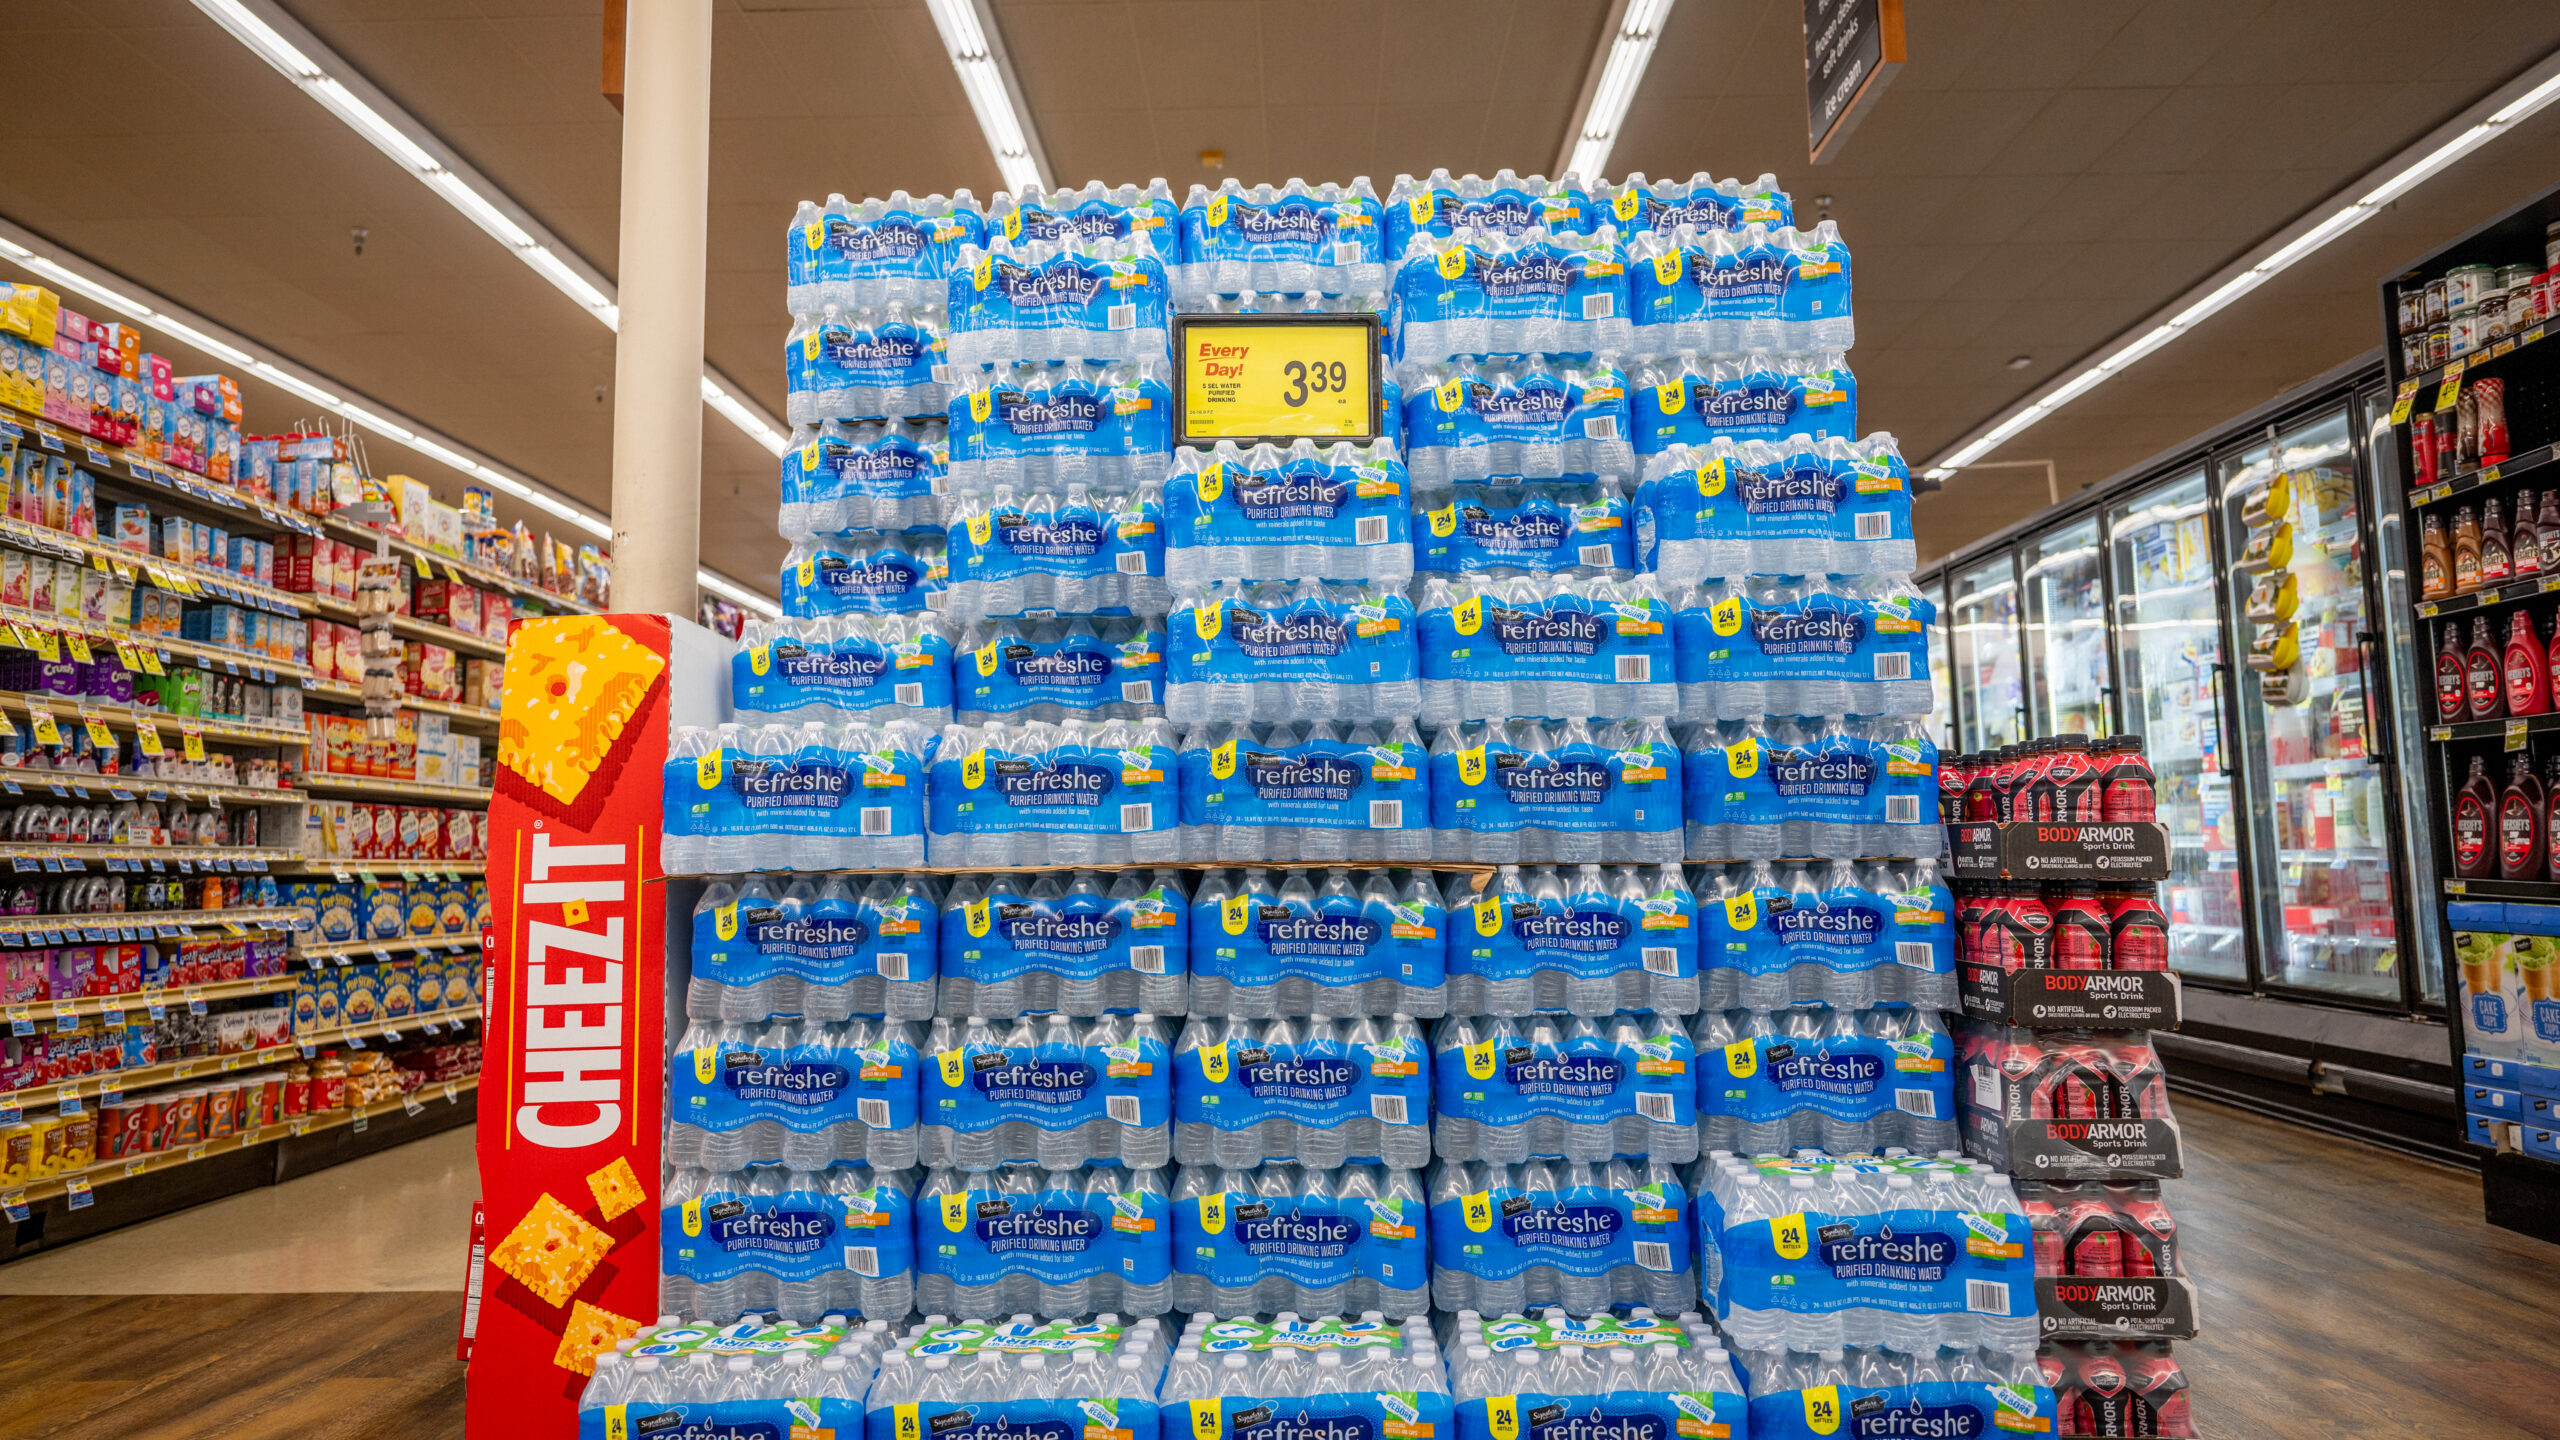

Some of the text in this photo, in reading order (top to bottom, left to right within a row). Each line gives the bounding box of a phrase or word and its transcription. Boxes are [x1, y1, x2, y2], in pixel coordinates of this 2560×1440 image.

[1825, 59, 1862, 120] ice cream
[1244, 209, 1320, 232] refreshe
[1451, 202, 1526, 227] refreshe
[1654, 200, 1728, 224] refreshe
[841, 227, 917, 249] refreshe
[1010, 264, 1092, 294] refreshe
[1483, 260, 1567, 284] refreshe
[1701, 260, 1782, 284] refreshe
[836, 341, 913, 358] refreshe
[1199, 344, 1249, 360] Every
[1205, 363, 1244, 378] Day!
[1011, 399, 1095, 422] refreshe
[1481, 389, 1564, 411] refreshe
[1704, 389, 1787, 413] refreshe
[837, 451, 914, 469] refreshe
[1204, 475, 1217, 488] 24
[1746, 473, 1835, 499] refreshe
[1244, 481, 1336, 504] refreshe
[1247, 506, 1333, 519] PURIFIED DRINKING WATER
[1011, 521, 1097, 542] refreshe
[1475, 518, 1559, 537] refreshe
[831, 568, 907, 586] refreshe
[1242, 618, 1337, 642] refreshe
[1503, 615, 1596, 639] refreshe
[1760, 615, 1853, 638] refreshe
[44, 663, 74, 676] Crush
[788, 654, 876, 674] refreshe
[1016, 654, 1102, 672] refreshe
[111, 670, 132, 682] Crush
[183, 682, 200, 694] Crush
[968, 764, 978, 775] 24
[1257, 760, 1350, 786] refreshe
[1466, 760, 1479, 771] 24
[1776, 756, 1866, 782] refreshe
[744, 765, 841, 792] refreshe
[1007, 765, 1101, 791] refreshe
[1508, 764, 1602, 789] refreshe
[1010, 793, 1098, 806] PURIFIED DRINKING WATER
[1960, 827, 1991, 842] BODYARMOR
[2038, 826, 2135, 842] BODYARMOR
[2083, 842, 2110, 851] Sports
[1011, 915, 1108, 939] refreshe
[1524, 914, 1619, 937] refreshe
[1778, 907, 1873, 931] refreshe
[759, 921, 856, 943] refreshe
[1269, 918, 1368, 942] refreshe
[1015, 940, 1107, 952] PURIFIED DRINKING WATER
[1968, 968, 1998, 984] BODYARMOR
[2045, 976, 2144, 992] BODYARMOR
[16, 984, 36, 1002] Kool-Aid
[2090, 992, 2144, 1000] Sports Drink
[2480, 1000, 2498, 1016] CAKE
[1474, 1054, 1489, 1066] 24
[1517, 1057, 1613, 1081] refreshe
[1778, 1054, 1874, 1079] refreshe
[14, 1070, 34, 1088] Kool-Aid
[737, 1067, 836, 1089] refreshe
[986, 1065, 1083, 1088] refreshe
[1250, 1060, 1348, 1085] refreshe
[1782, 1080, 1873, 1094] PURIFIED DRINKING WATER
[2046, 1124, 2146, 1140] BODYARMOR
[2092, 1140, 2120, 1148] Sports
[1208, 1206, 1219, 1218] 24
[1514, 1209, 1610, 1233] refreshe
[723, 1213, 821, 1237] refreshe
[989, 1211, 1088, 1236] refreshe
[1247, 1215, 1348, 1241] refreshe
[1969, 1219, 2002, 1242] REBORN
[1782, 1229, 1799, 1243] 24
[1250, 1243, 1343, 1257] PURIFIED DRINKING WATER
[1832, 1234, 1943, 1262] refreshe
[1837, 1263, 1942, 1280] PURIFIED DRINKING WATER
[1860, 1280, 1886, 1288] minerals
[1888, 1282, 1908, 1291] added
[2055, 1286, 2156, 1302] BODYARMOR
[2102, 1302, 2156, 1311] Sports Drink
[1496, 1411, 1512, 1424] 24
[1680, 1400, 1711, 1422] REBORN
[1814, 1402, 1832, 1416] 24
[1544, 1417, 1652, 1440] refreshe
[1861, 1412, 1970, 1436] refreshe
